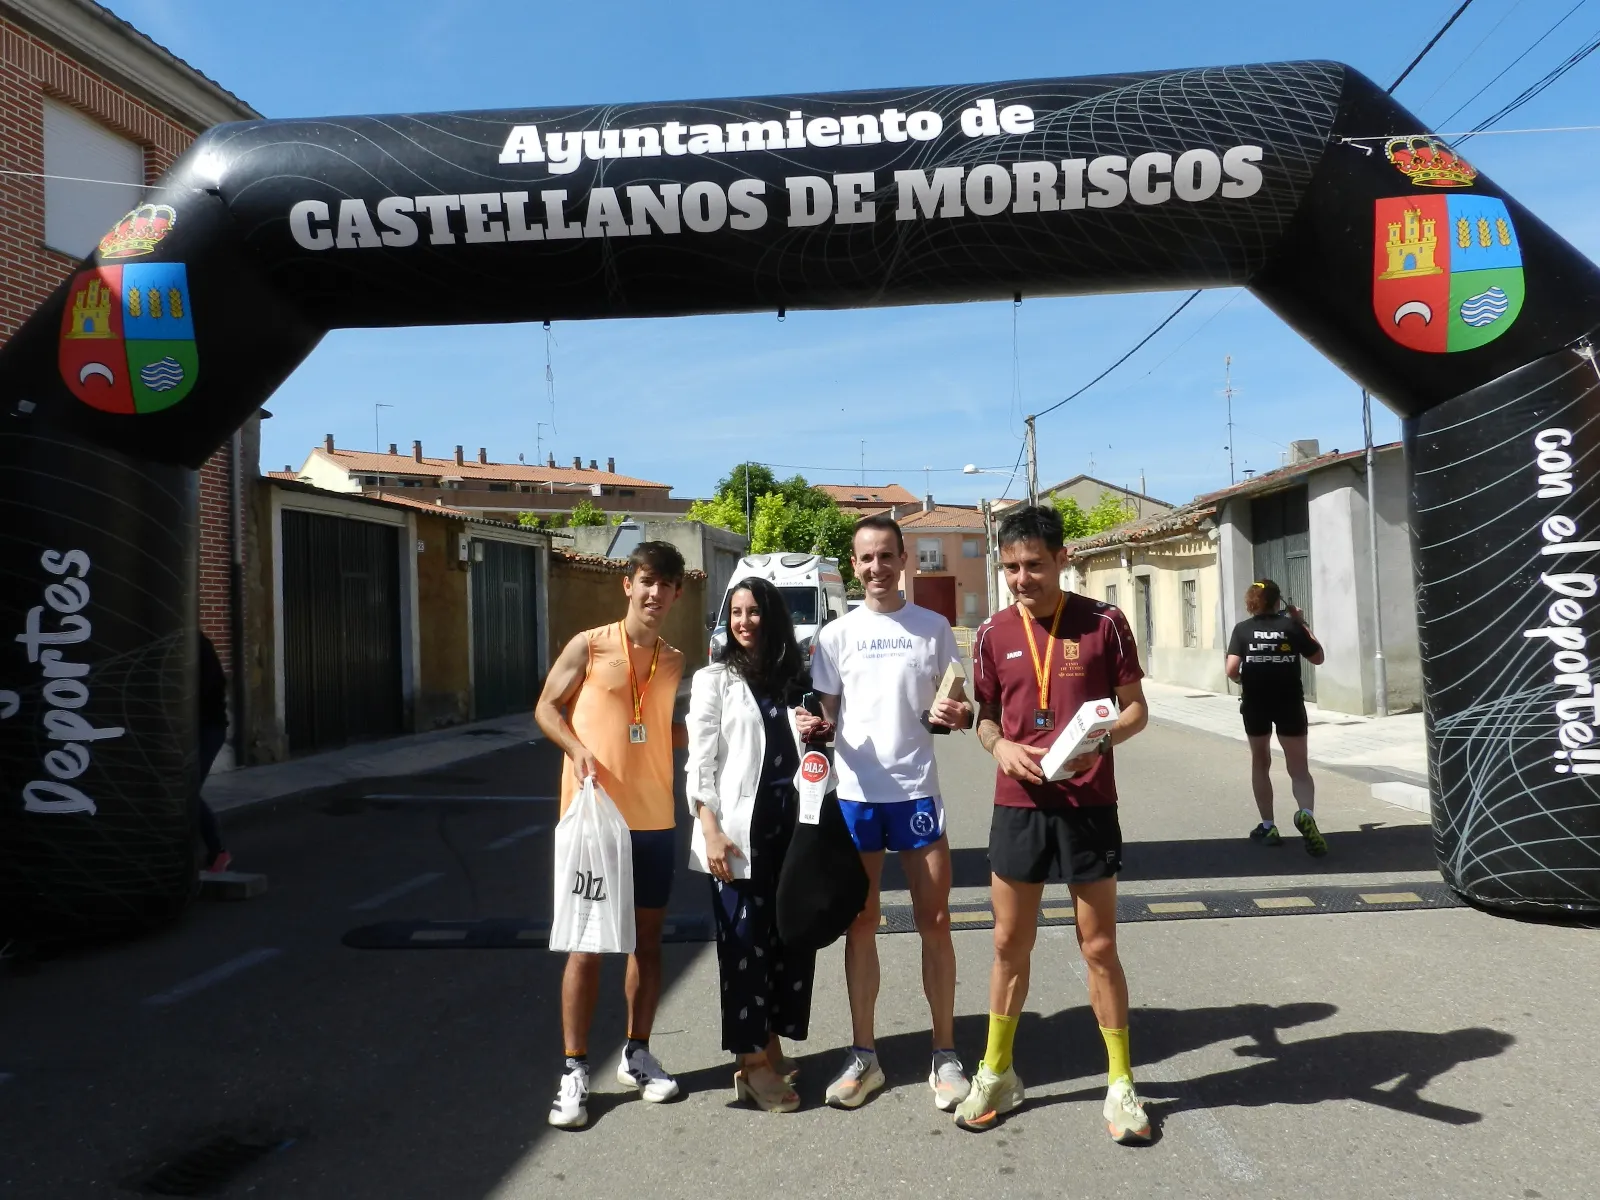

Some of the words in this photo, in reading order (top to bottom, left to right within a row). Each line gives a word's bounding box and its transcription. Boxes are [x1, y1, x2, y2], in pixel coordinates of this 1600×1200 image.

[499, 107, 943, 174] Ayuntamiento
[961, 98, 1035, 137] de
[289, 178, 768, 250] CASTELLANOS
[785, 172, 876, 227] DE
[894, 145, 1264, 221] MORISCOS
[1534, 427, 1573, 499] con
[1541, 514, 1600, 556] el
[857, 640, 867, 651] LA
[870, 636, 913, 650] ARMUÑA
[1246, 655, 1296, 663] REPEAT
[1249, 643, 1277, 651] LIFT
[1280, 643, 1291, 652] &
[15, 549, 125, 816] Deportes
